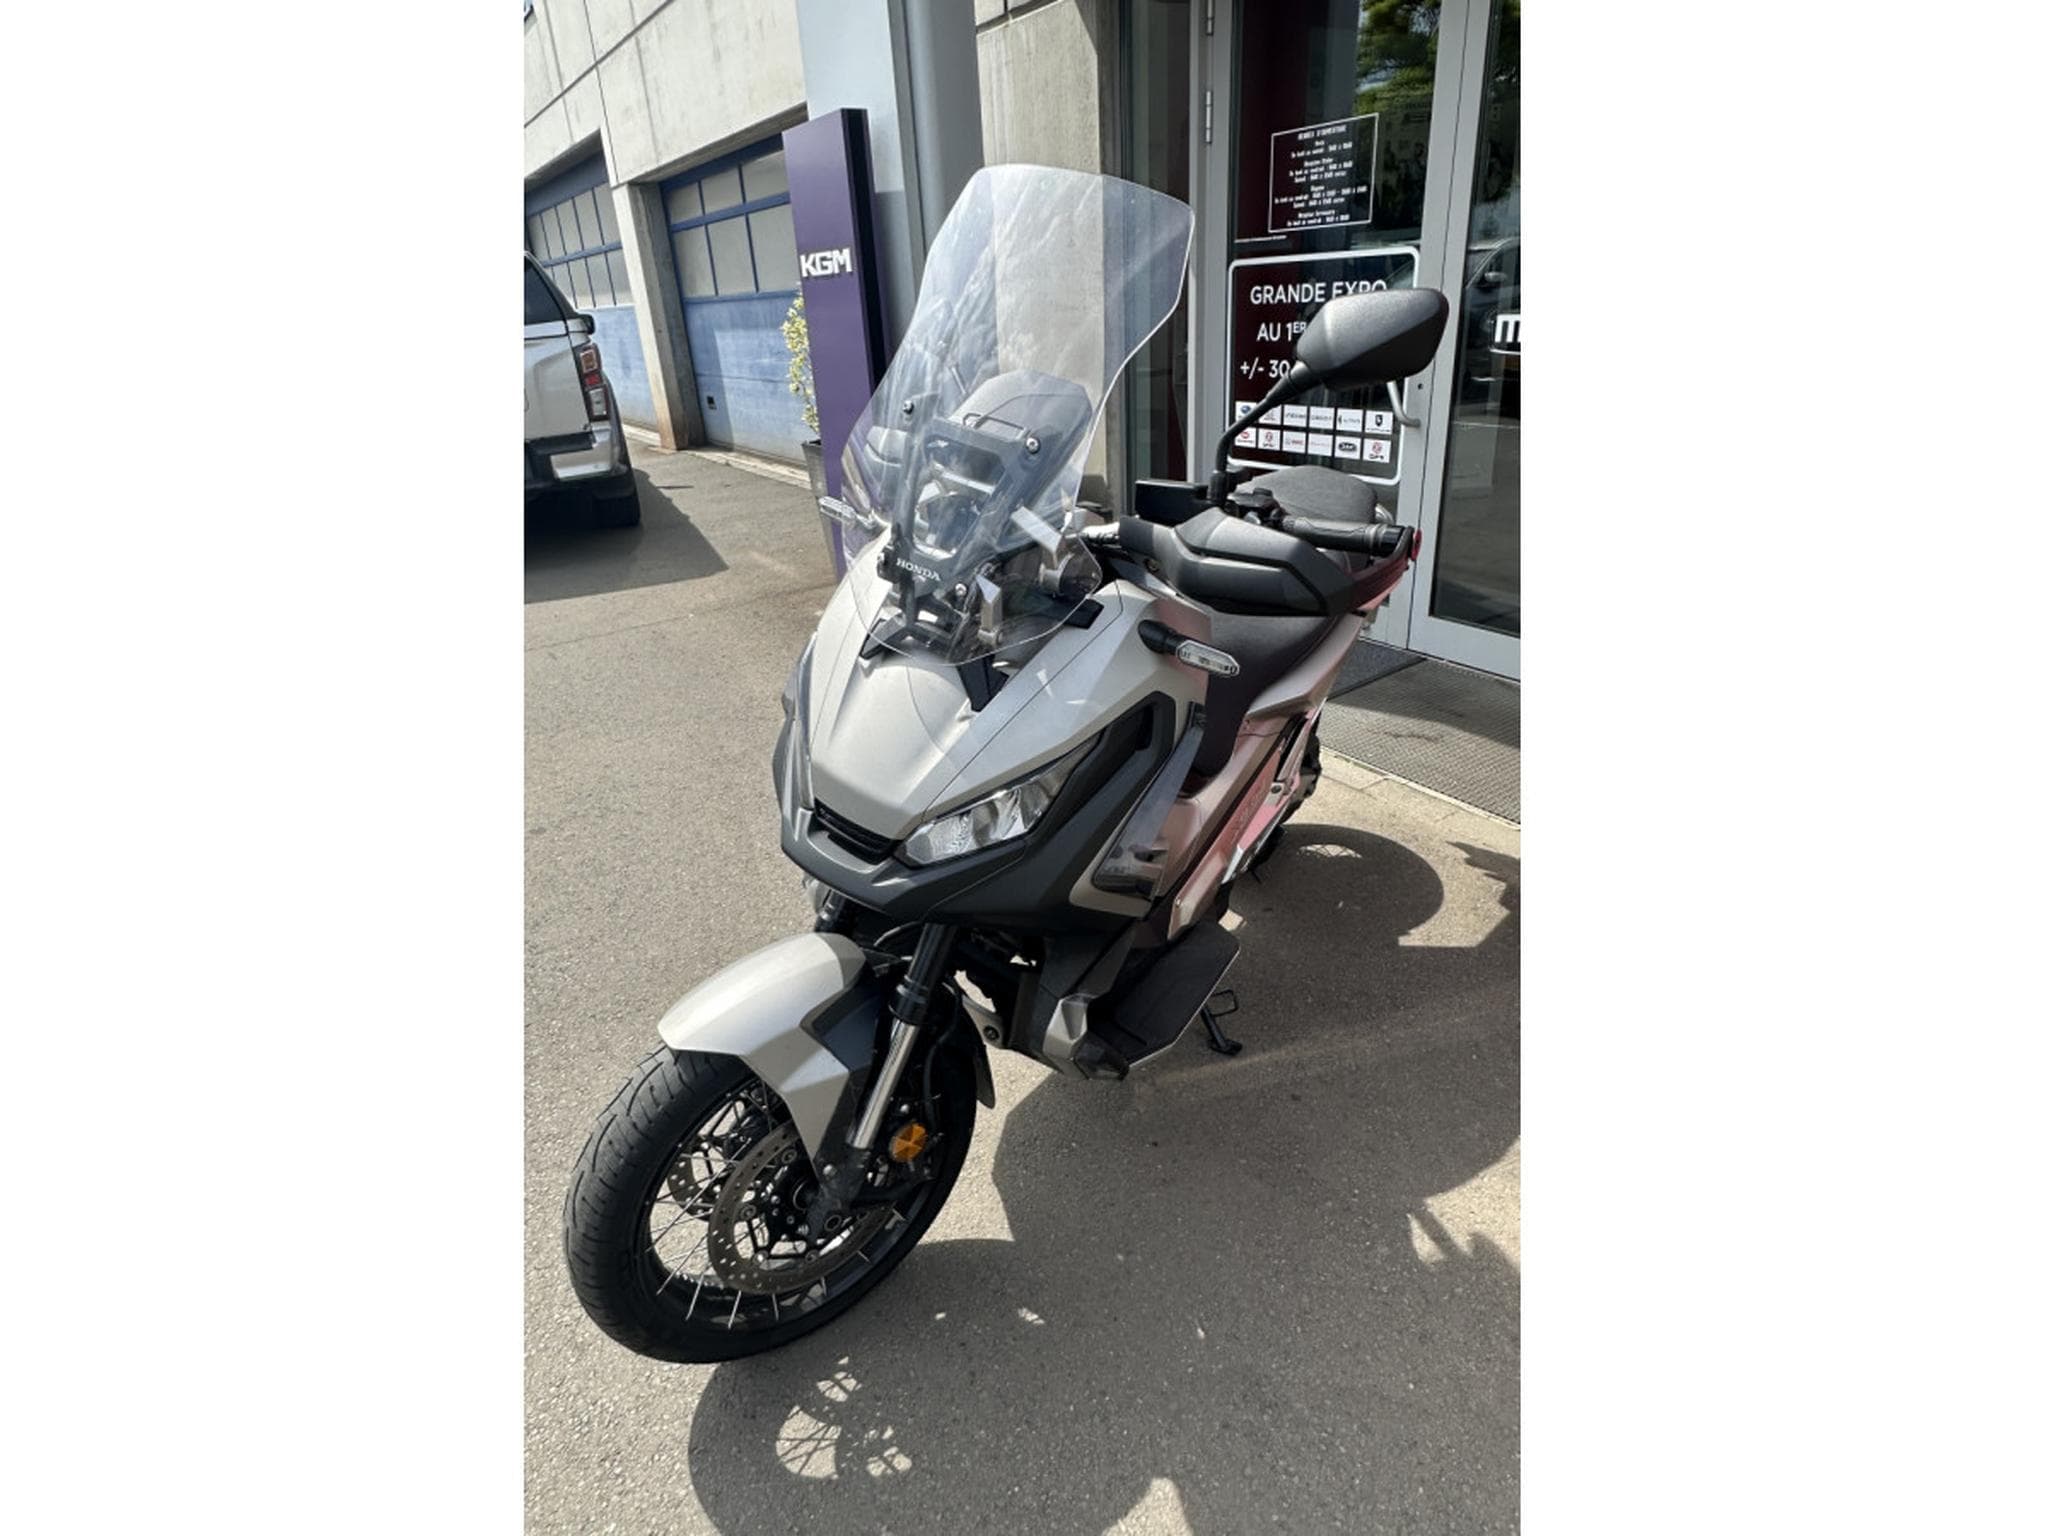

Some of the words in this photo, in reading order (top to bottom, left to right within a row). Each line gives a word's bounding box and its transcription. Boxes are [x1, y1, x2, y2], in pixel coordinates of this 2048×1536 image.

[800, 247, 852, 278] KGM
[1250, 282, 1327, 305] GRANDE
[1256, 322, 1281, 342] AU
[1240, 357, 1264, 380] +/-
[896, 557, 941, 581] HONDA
